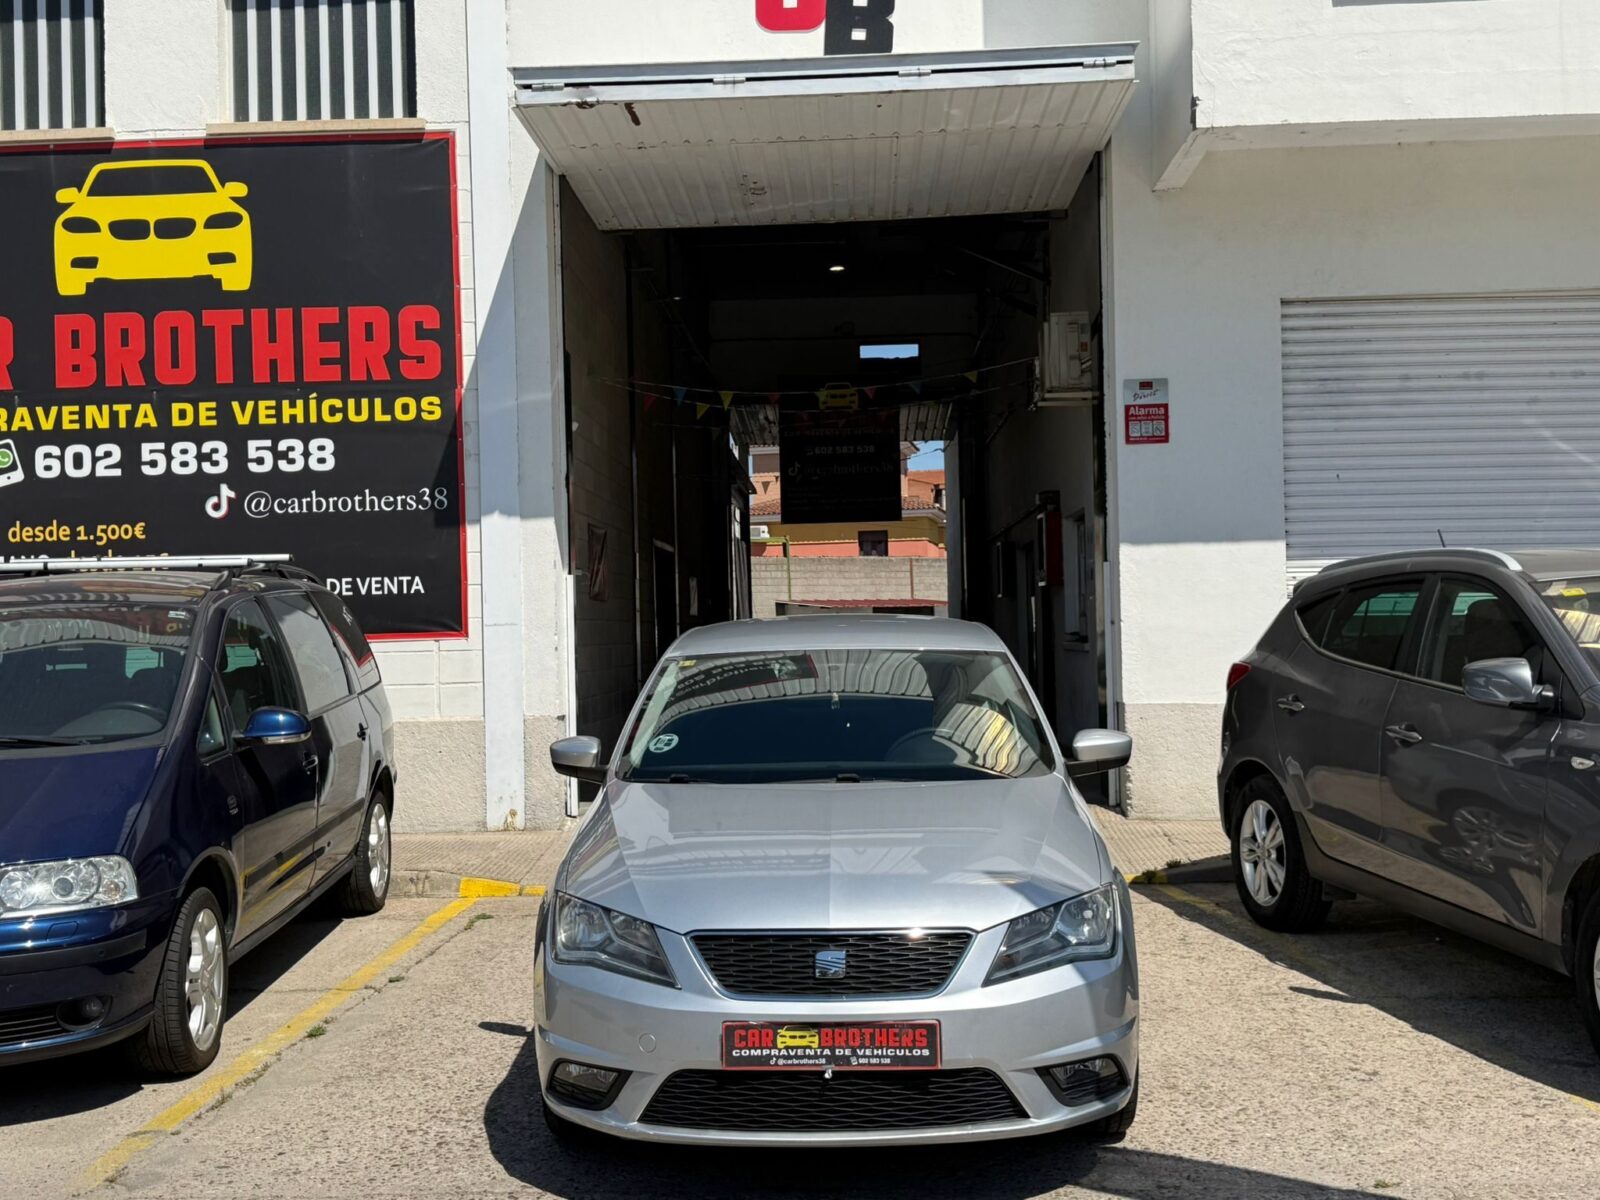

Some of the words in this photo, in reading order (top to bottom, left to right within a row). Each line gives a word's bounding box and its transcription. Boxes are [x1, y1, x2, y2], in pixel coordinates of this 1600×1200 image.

[54, 304, 442, 389] BROTHERS
[172, 401, 217, 427] DE
[231, 392, 442, 425] VEHÍCULOS
[1128, 406, 1165, 415] Alarma
[34, 443, 122, 478] 602
[141, 441, 229, 476] 583
[247, 438, 336, 473] 538
[244, 486, 448, 518] @carbrothers38
[8, 519, 71, 542] desde
[76, 522, 146, 545] 1.500€
[326, 577, 353, 595] DE
[356, 575, 425, 595] VENTA
[735, 1028, 774, 1048] CAR
[821, 1028, 928, 1048] BROTHERS
[732, 1048, 831, 1056] COMPRAVENTA
[835, 1048, 852, 1056] DE
[856, 1047, 930, 1056] VEHÍCULOS
